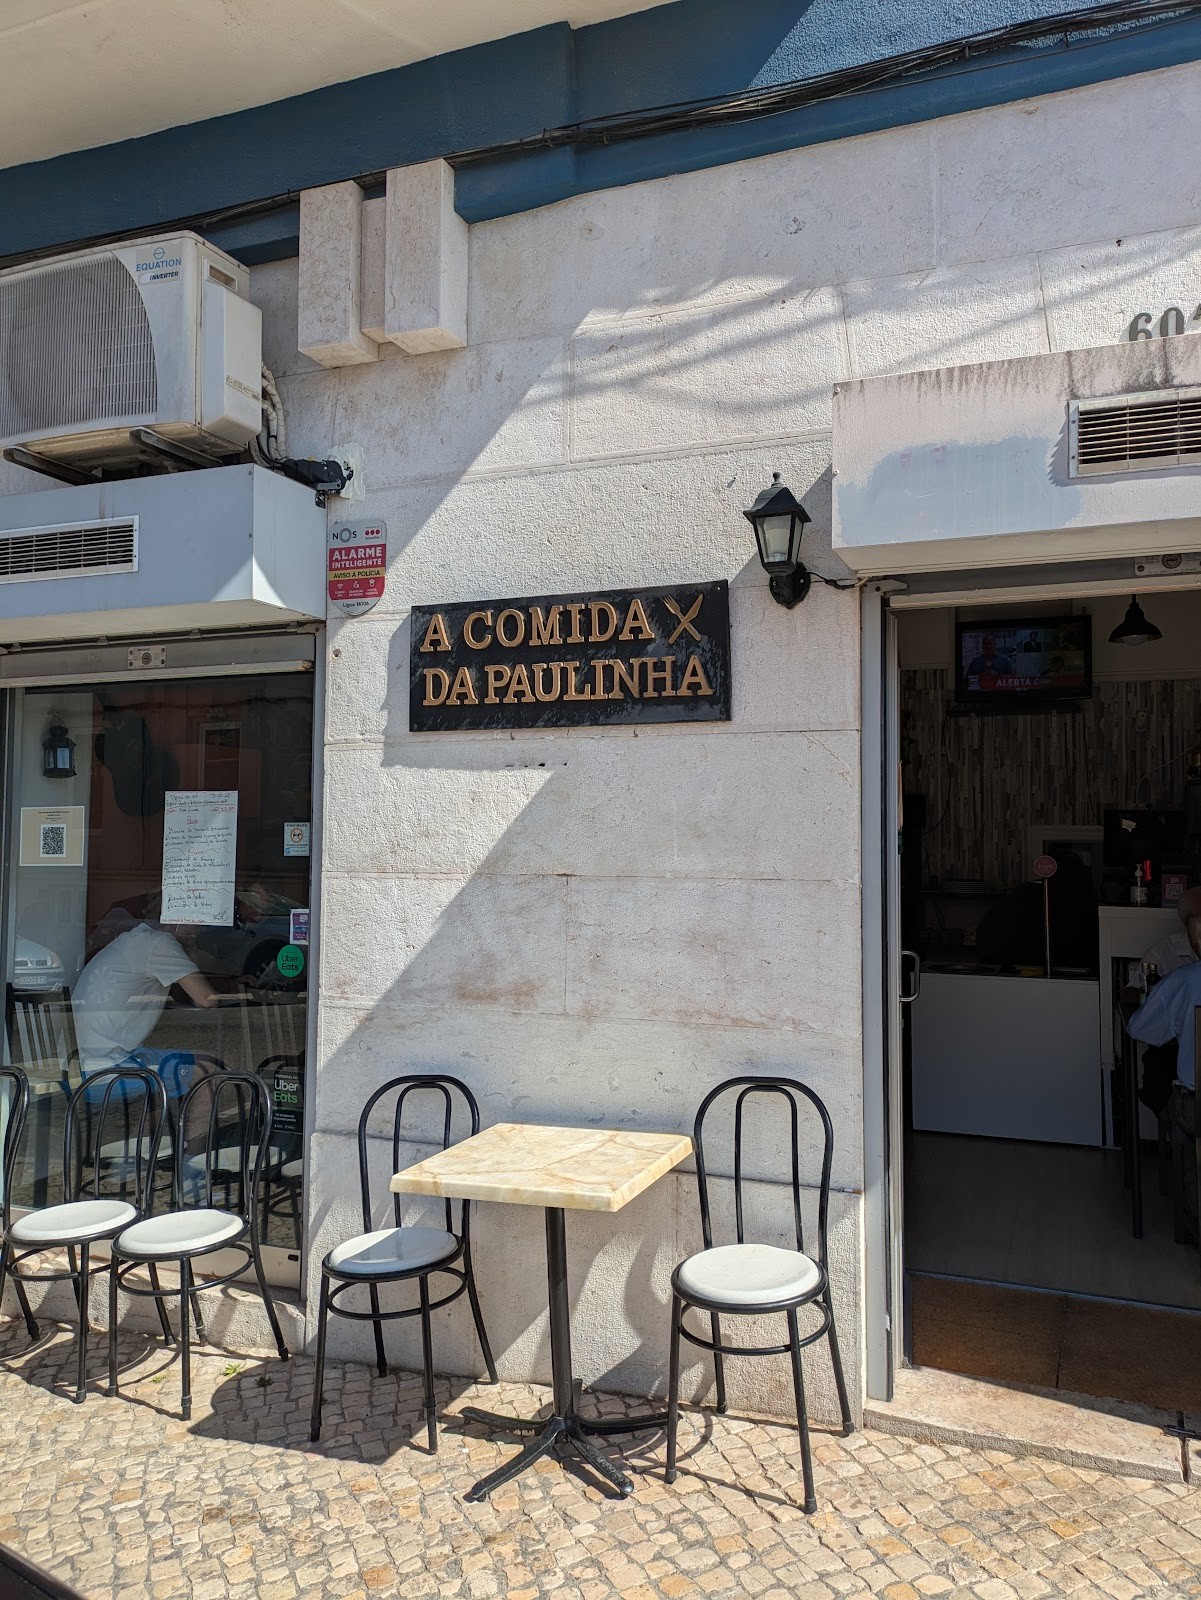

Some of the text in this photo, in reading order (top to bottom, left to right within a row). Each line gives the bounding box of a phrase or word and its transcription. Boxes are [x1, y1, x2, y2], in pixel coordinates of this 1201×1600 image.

[136, 258, 182, 271] EQUATION
[150, 271, 178, 280] INVERTER
[332, 528, 357, 543] NOS
[333, 547, 382, 560] ALARME
[333, 559, 381, 568] INTELIGENTE
[420, 599, 655, 652] A COMIDA
[423, 655, 713, 706] DA PAULINHA
[996, 678, 1031, 687] ALERTA
[281, 954, 299, 963] Uber
[281, 963, 299, 971] Eats
[275, 1079, 298, 1091] Uber
[274, 1091, 298, 1103] Eats
